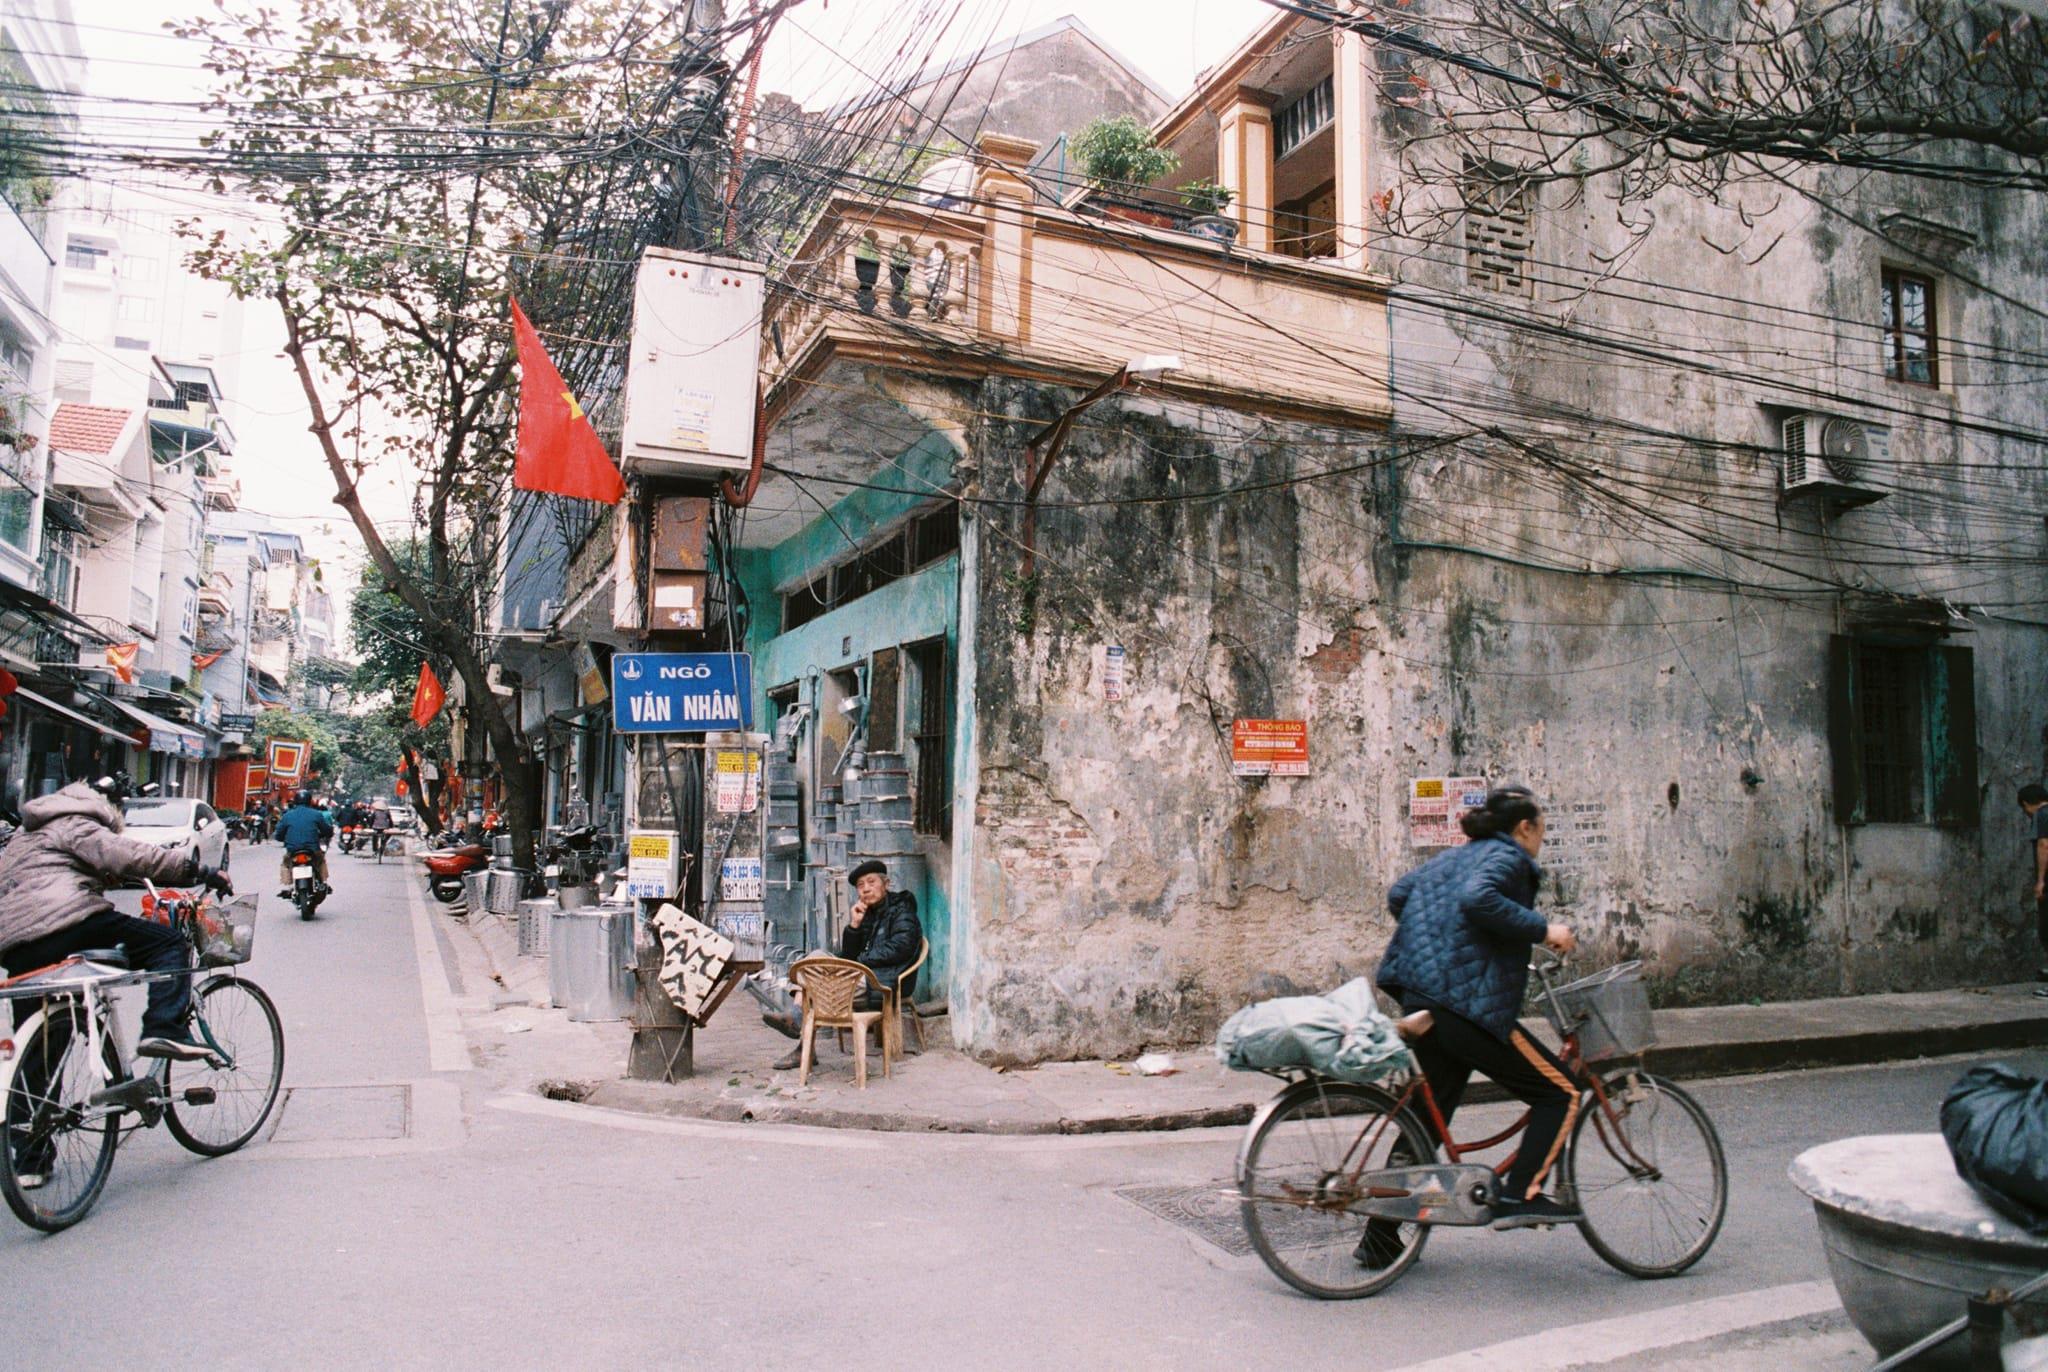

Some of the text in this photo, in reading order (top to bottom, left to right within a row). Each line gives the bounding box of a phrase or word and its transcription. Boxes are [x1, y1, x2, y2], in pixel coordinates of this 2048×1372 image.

[660, 663, 711, 679] NGÕ
[630, 689, 739, 722] VĂN NHÂN
